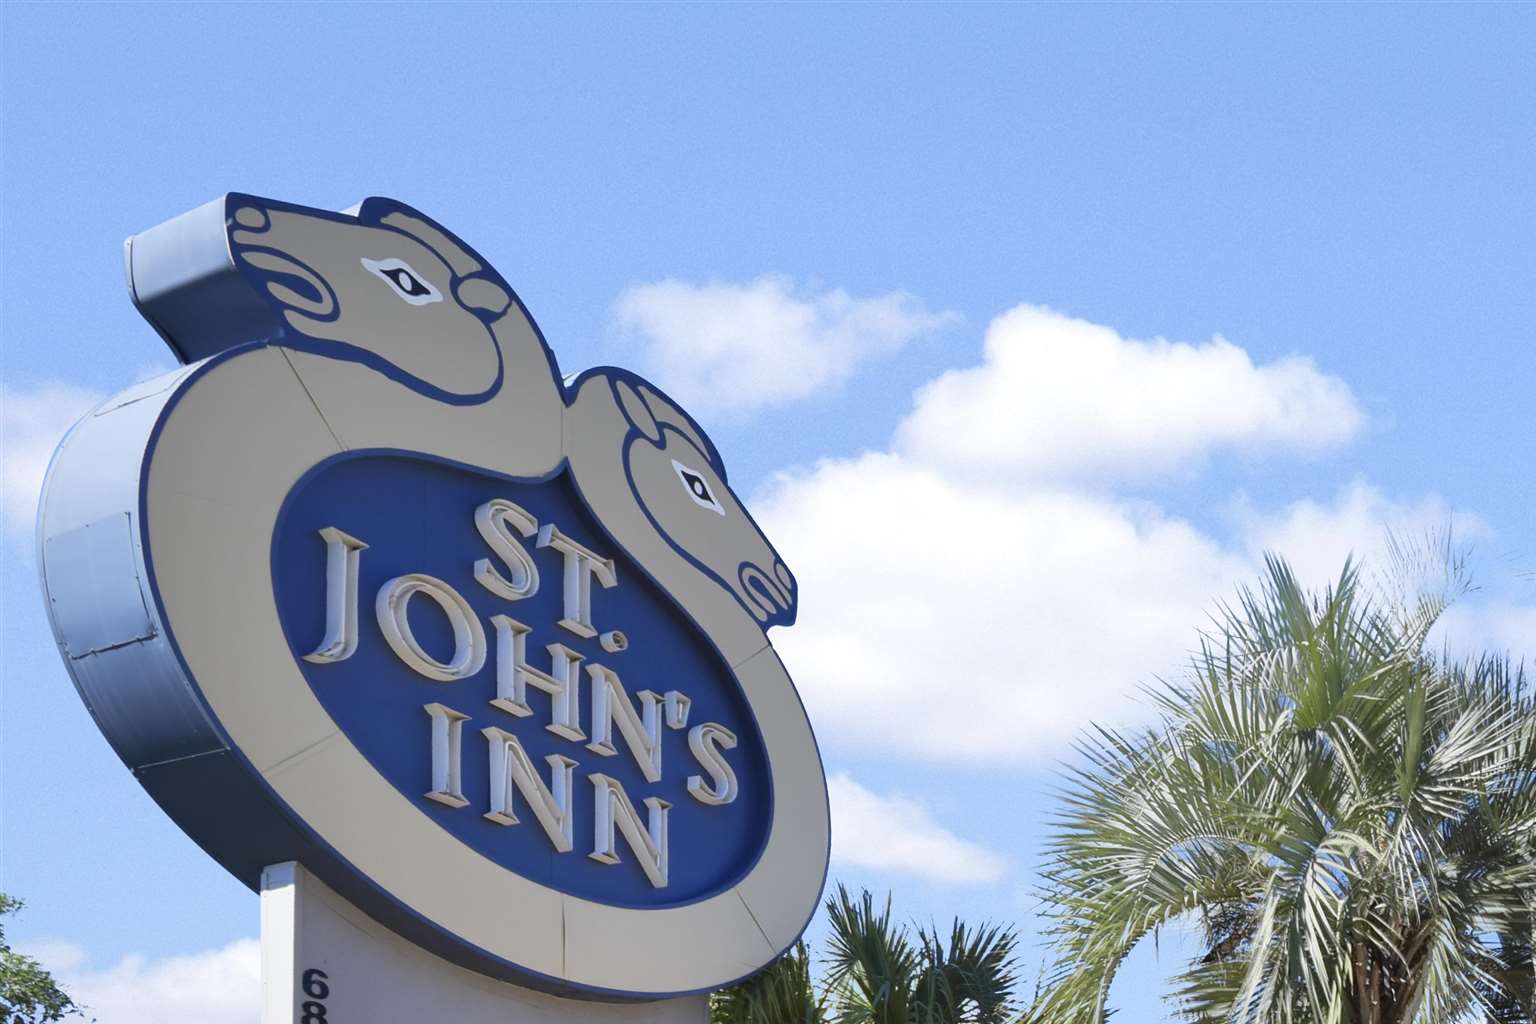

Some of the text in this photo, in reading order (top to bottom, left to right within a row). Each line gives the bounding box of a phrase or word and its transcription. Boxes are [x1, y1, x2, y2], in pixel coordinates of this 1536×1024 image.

[302, 526, 738, 805] JOHN'S
[474, 498, 628, 652] ST.
[424, 702, 672, 888] INN
